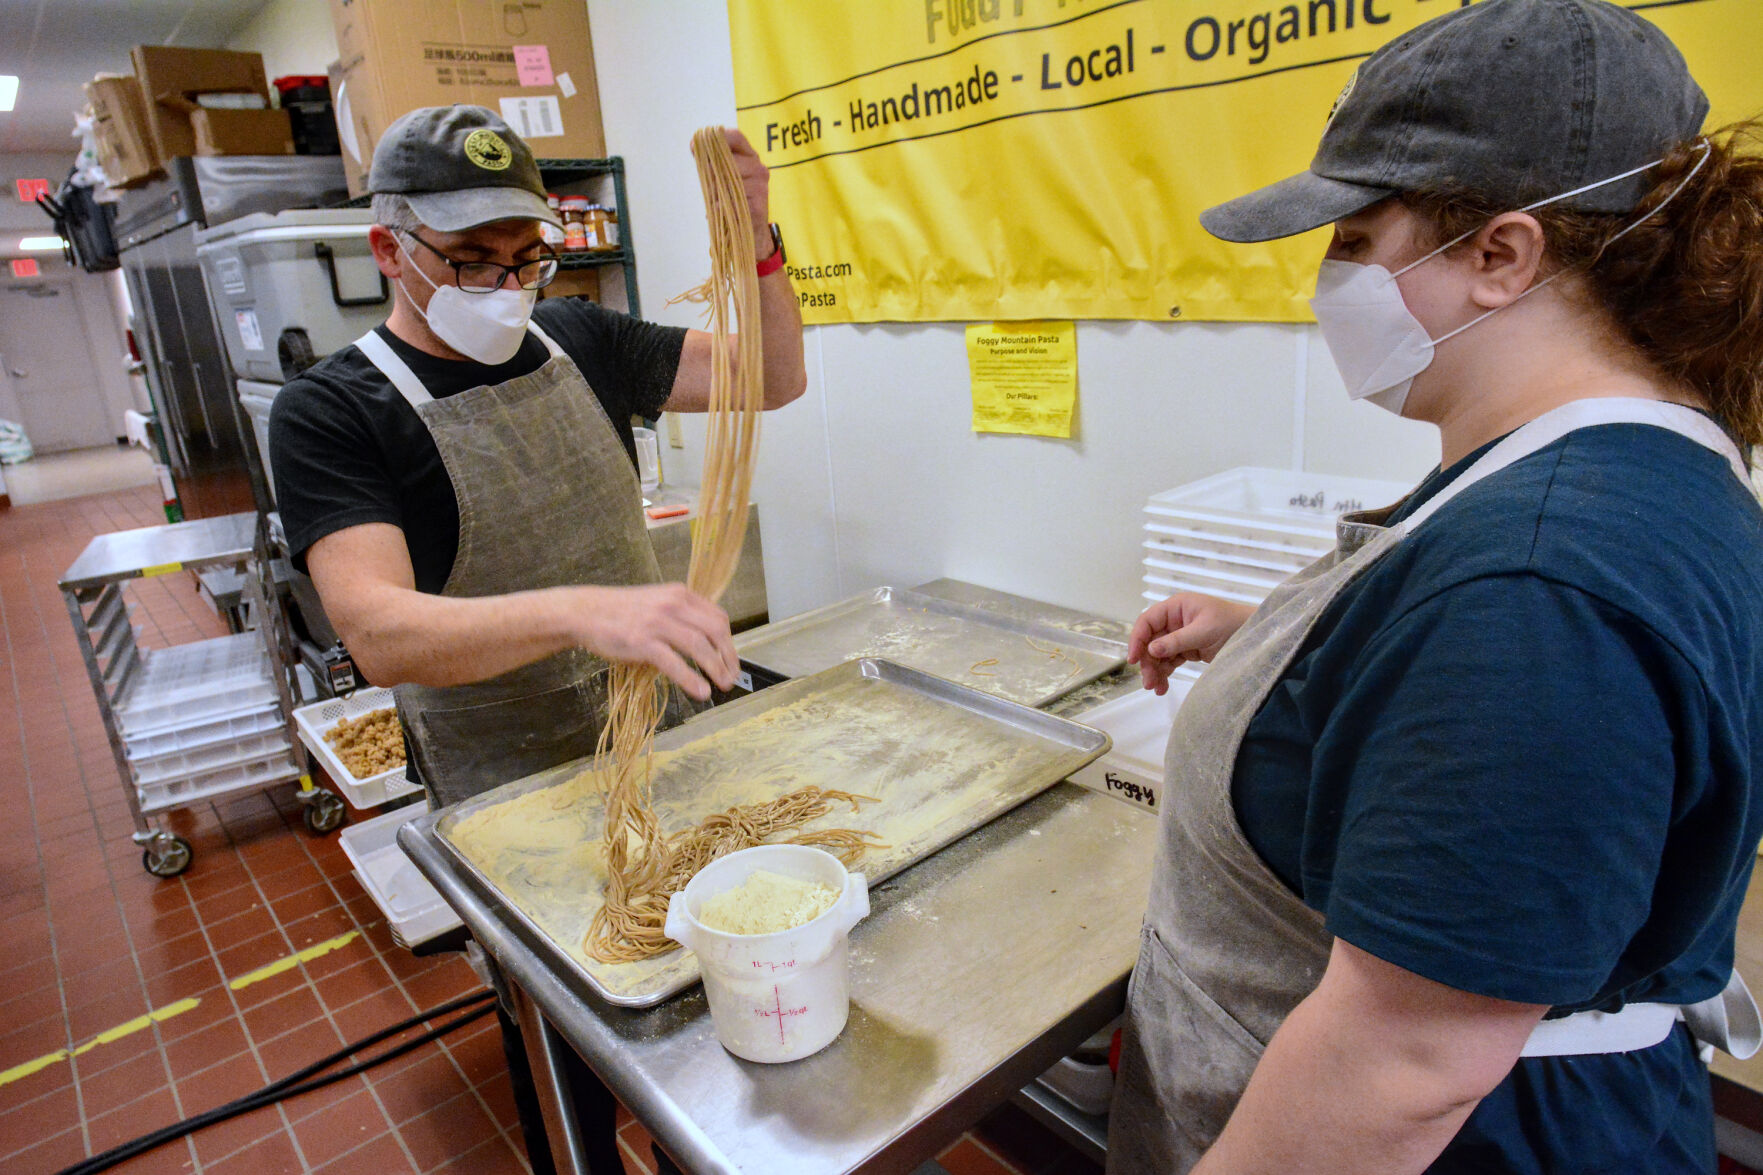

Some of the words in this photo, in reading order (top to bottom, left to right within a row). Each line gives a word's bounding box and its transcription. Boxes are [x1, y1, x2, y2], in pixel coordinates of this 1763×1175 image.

[766, 109, 822, 152] Fresh
[850, 64, 998, 132] Handmade
[1041, 28, 1134, 90] Local
[1185, 0, 1391, 64] Organic
[977, 337, 999, 346] Foggy
[1000, 335, 1036, 344] Mountain
[1038, 335, 1060, 344] Pasta
[990, 348, 1014, 356] Purpose
[1006, 392, 1016, 400] Our
[1105, 772, 1155, 806] Foggy
